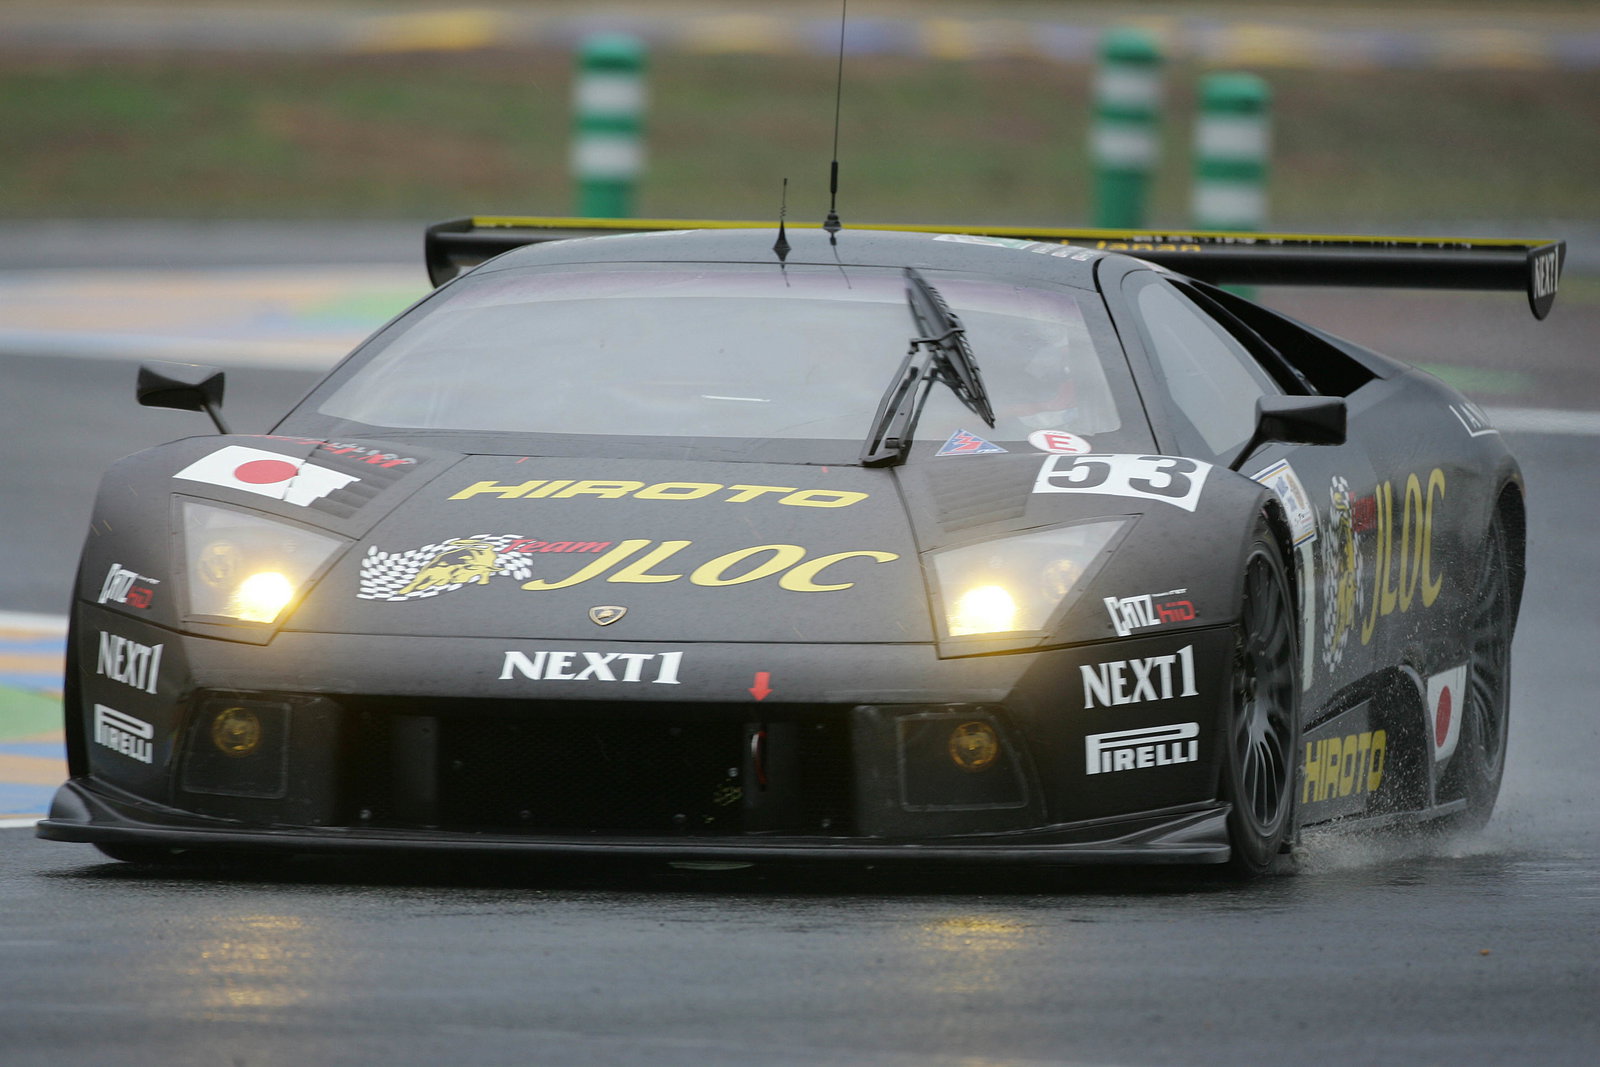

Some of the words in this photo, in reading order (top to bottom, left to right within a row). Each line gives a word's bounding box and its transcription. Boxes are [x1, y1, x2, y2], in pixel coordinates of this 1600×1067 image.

[1533, 246, 1559, 299] NEXT1
[1043, 433, 1078, 452] E
[448, 480, 870, 508] HIROTO
[500, 538, 614, 553] Team
[521, 540, 900, 592] JLOC
[1361, 468, 1446, 646] JLOC
[96, 631, 164, 694] NEXT1
[498, 651, 683, 685] NEXT1
[1079, 645, 1199, 709] NEXT1
[94, 703, 154, 764] PIRELLI
[1085, 722, 1200, 775] PIRELLI
[1302, 729, 1387, 804] HIROTO
